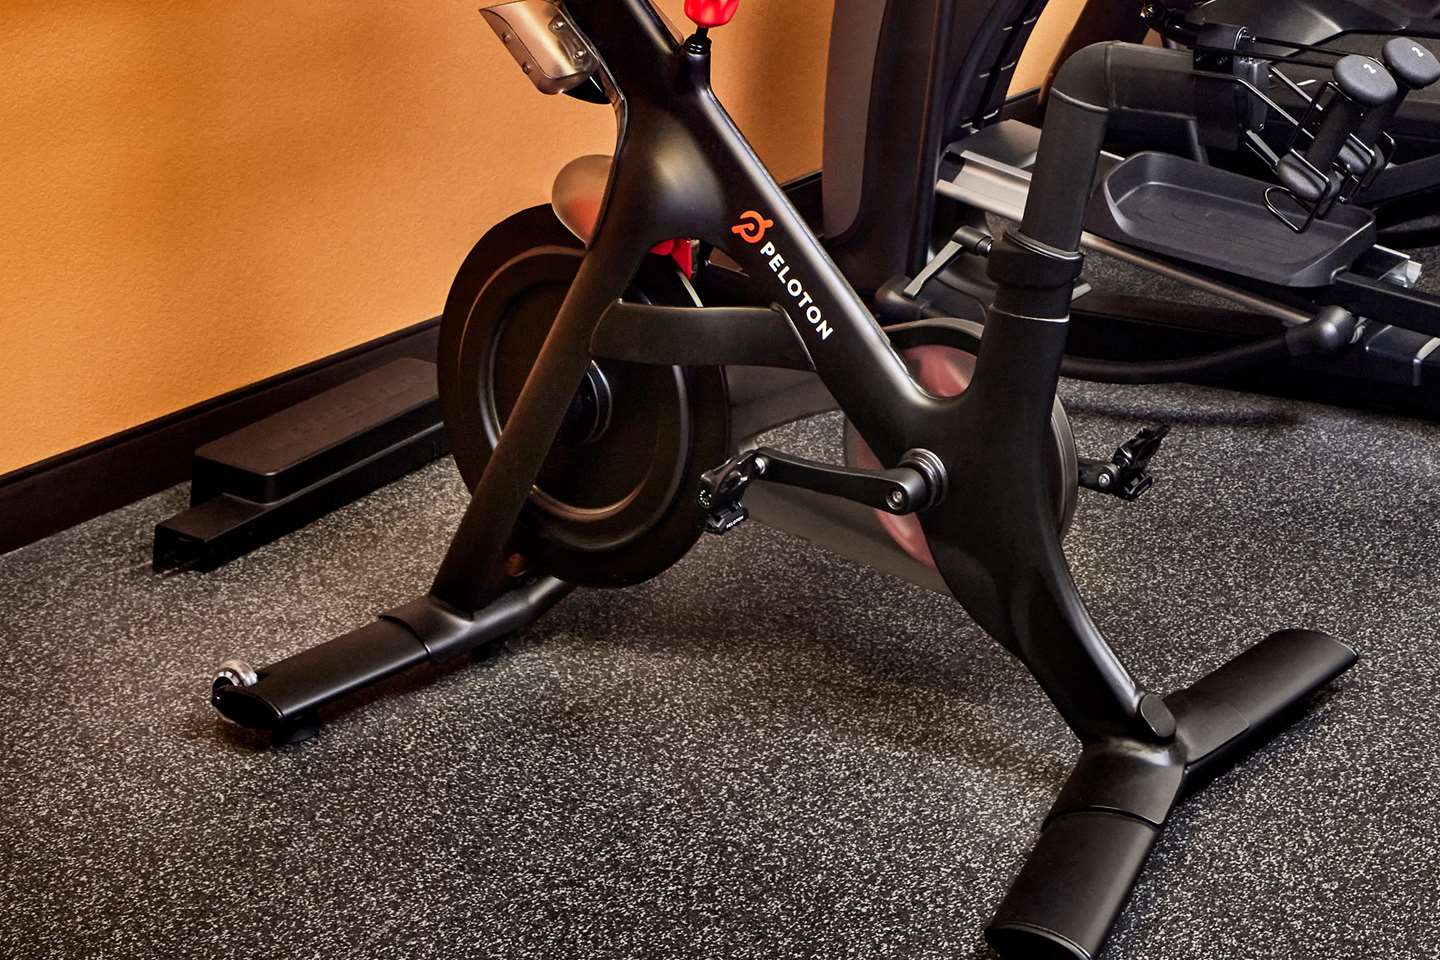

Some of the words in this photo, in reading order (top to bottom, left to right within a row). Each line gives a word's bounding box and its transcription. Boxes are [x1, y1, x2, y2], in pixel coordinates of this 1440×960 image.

[1411, 47, 1424, 57] 2
[1363, 64, 1376, 74] 2
[759, 241, 834, 341] PELOTON
